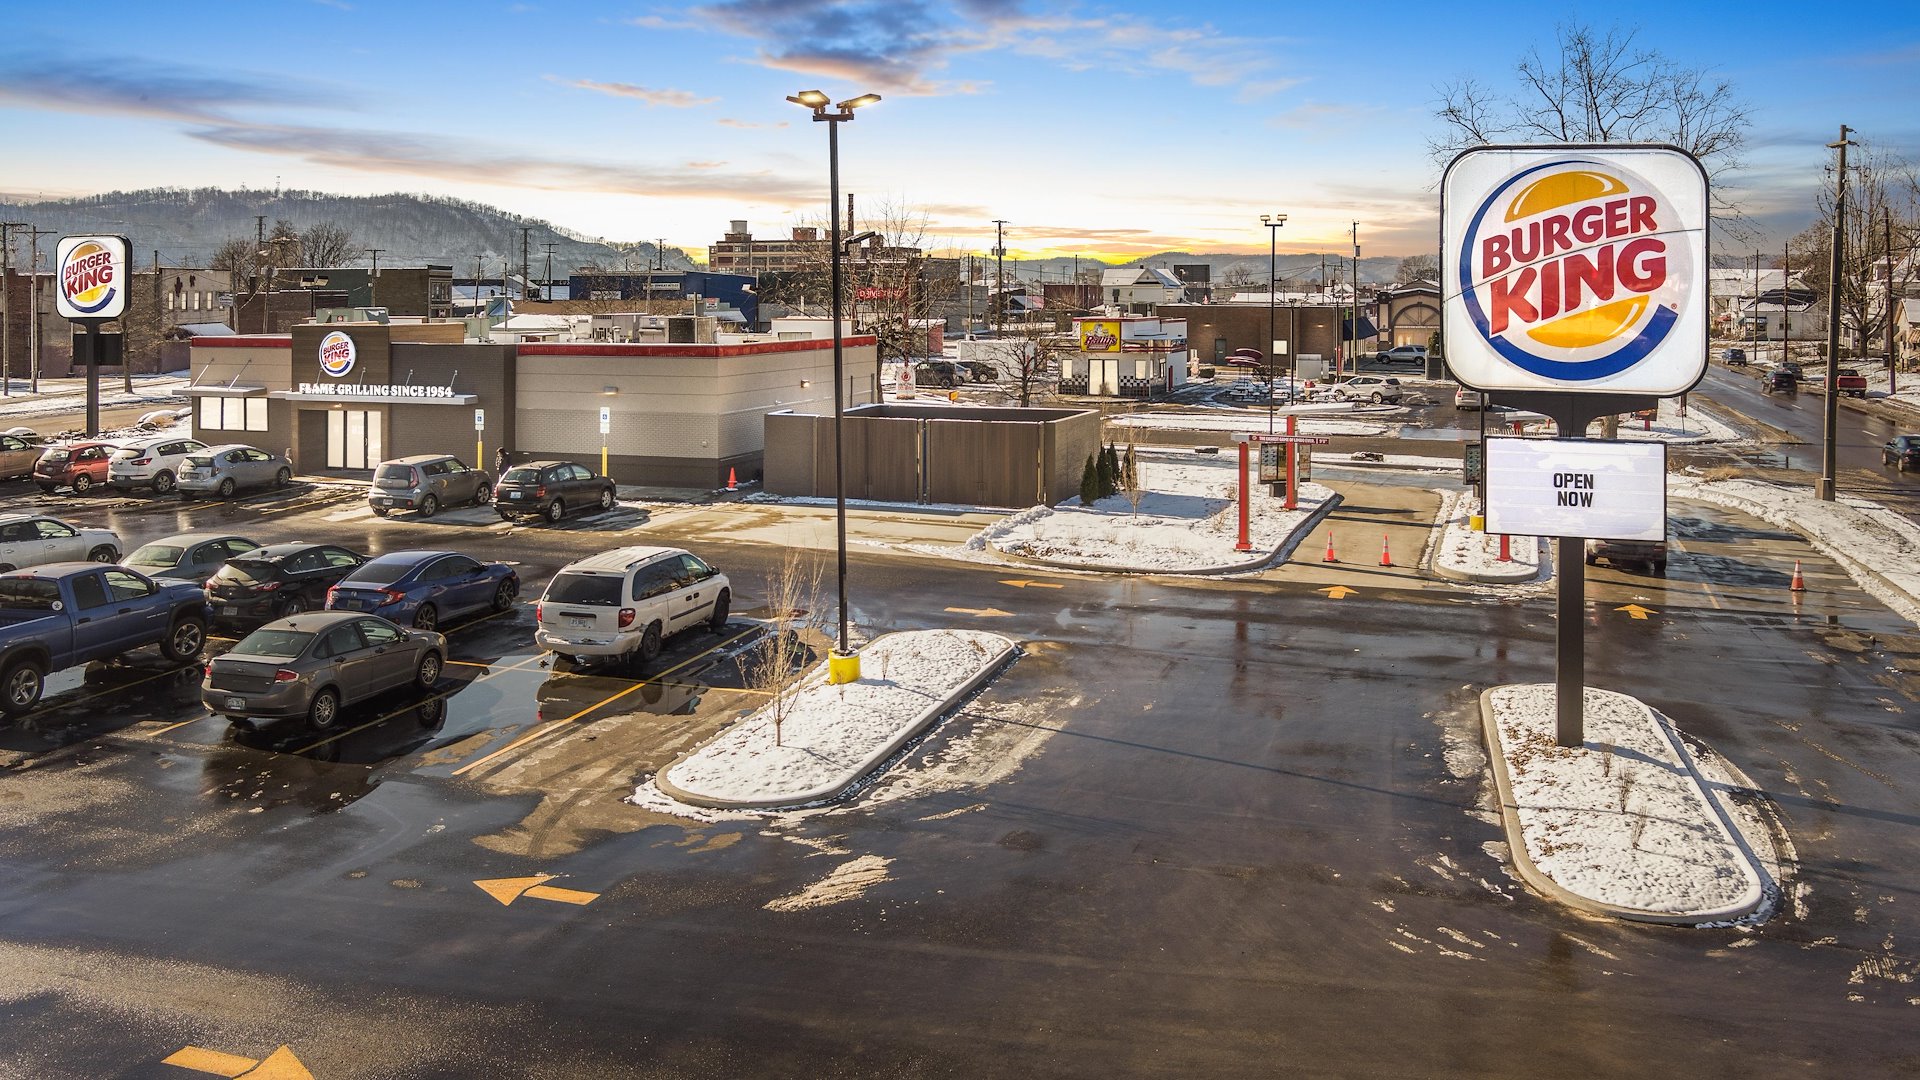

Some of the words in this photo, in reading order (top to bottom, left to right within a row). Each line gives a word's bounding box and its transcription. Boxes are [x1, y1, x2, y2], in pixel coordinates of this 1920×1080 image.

[1483, 196, 1658, 279] BURGER
[65, 252, 111, 280] BURGER
[67, 265, 113, 298] KING
[1490, 238, 1667, 335] KING
[323, 341, 349, 355] BURGER
[1086, 335, 1117, 349] Rally's
[324, 349, 350, 365] KING
[299, 383, 336, 395] FLAME
[337, 384, 391, 396] GRILLING
[391, 385, 425, 397] SINCE
[426, 386, 453, 398] 1954
[1553, 473, 1593, 489] OPEN
[1557, 491, 1593, 507] NOW
